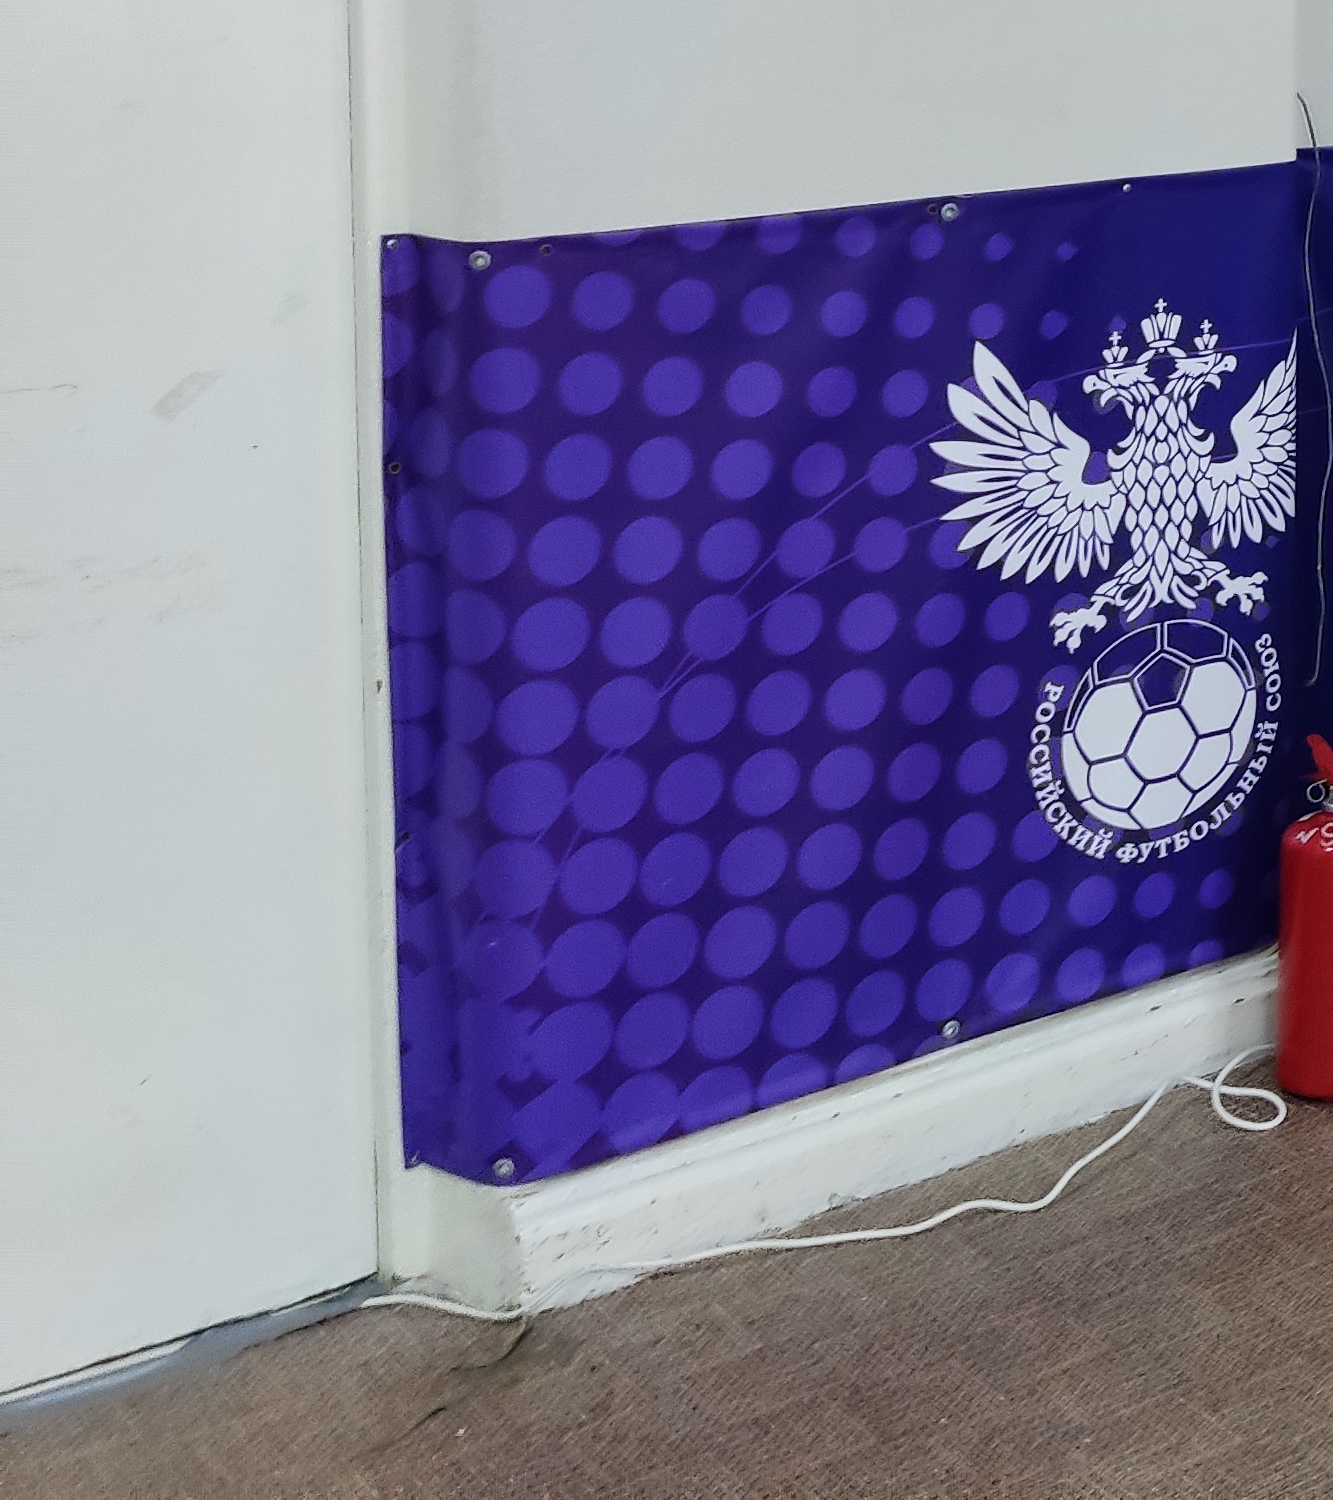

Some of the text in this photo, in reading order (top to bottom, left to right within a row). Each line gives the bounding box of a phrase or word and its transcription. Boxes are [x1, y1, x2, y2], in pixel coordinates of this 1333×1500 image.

[1028, 632, 1283, 865] РОССИЙСКИЙ ФУТБОЛЬНЫЙ СОЮЗ
